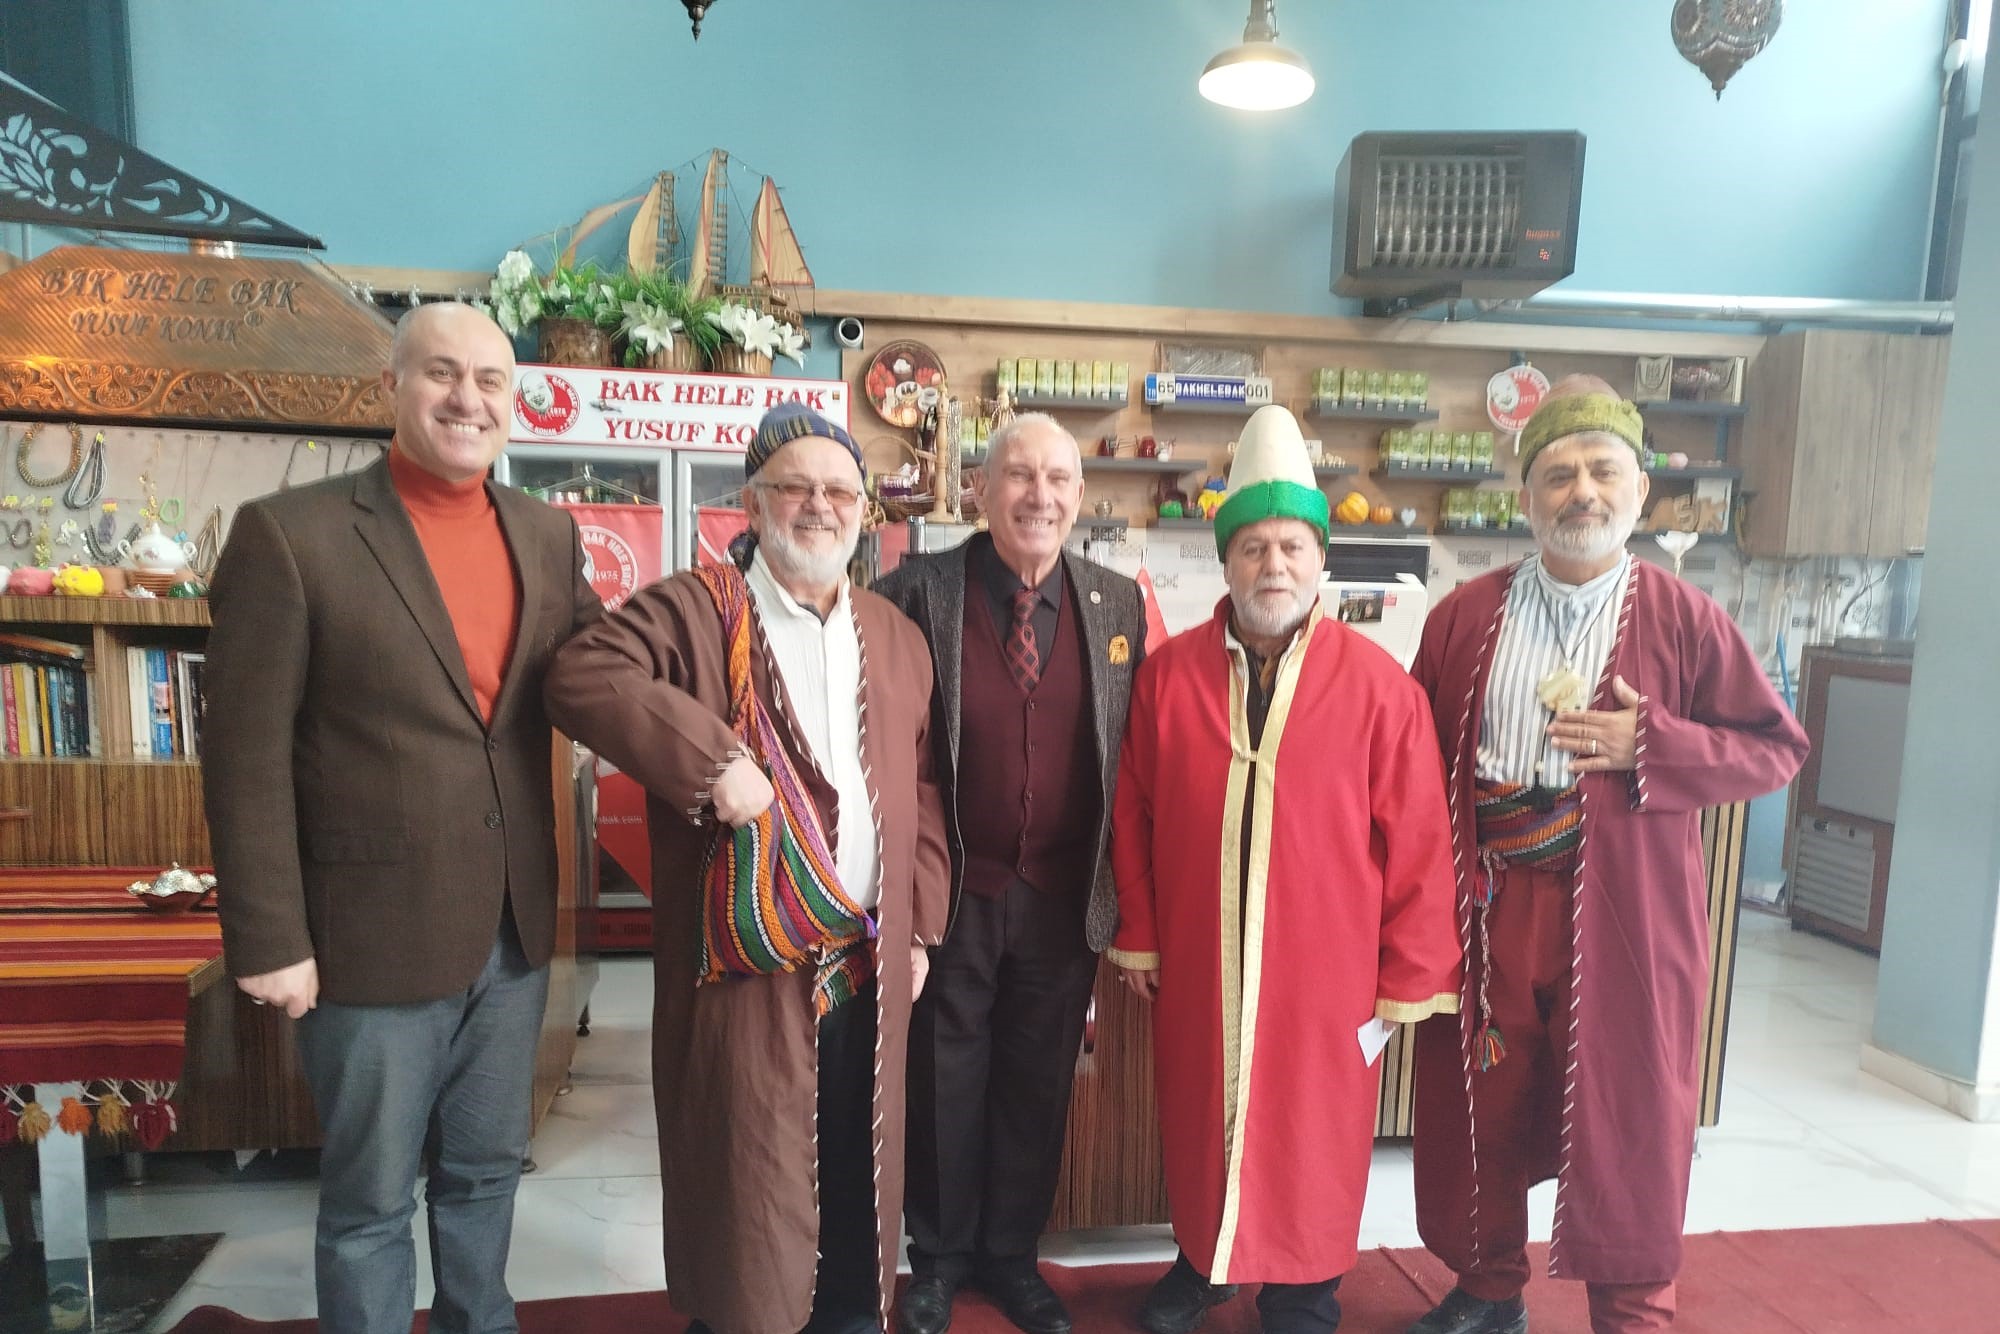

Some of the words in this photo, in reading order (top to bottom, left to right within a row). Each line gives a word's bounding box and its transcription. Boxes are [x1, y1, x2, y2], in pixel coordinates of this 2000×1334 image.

[41, 267, 117, 303] BAK
[123, 272, 219, 303] HELE
[230, 278, 304, 316] BAK
[69, 308, 154, 337] YUSUF
[599, 378, 664, 402] BAK
[671, 382, 755, 407] HELE
[763, 385, 827, 411] BAK
[1158, 380, 1175, 394] 65
[1175, 381, 1246, 400] BAKHELEBAK
[1246, 383, 1270, 400] 001
[604, 416, 706, 443] YUSUF
